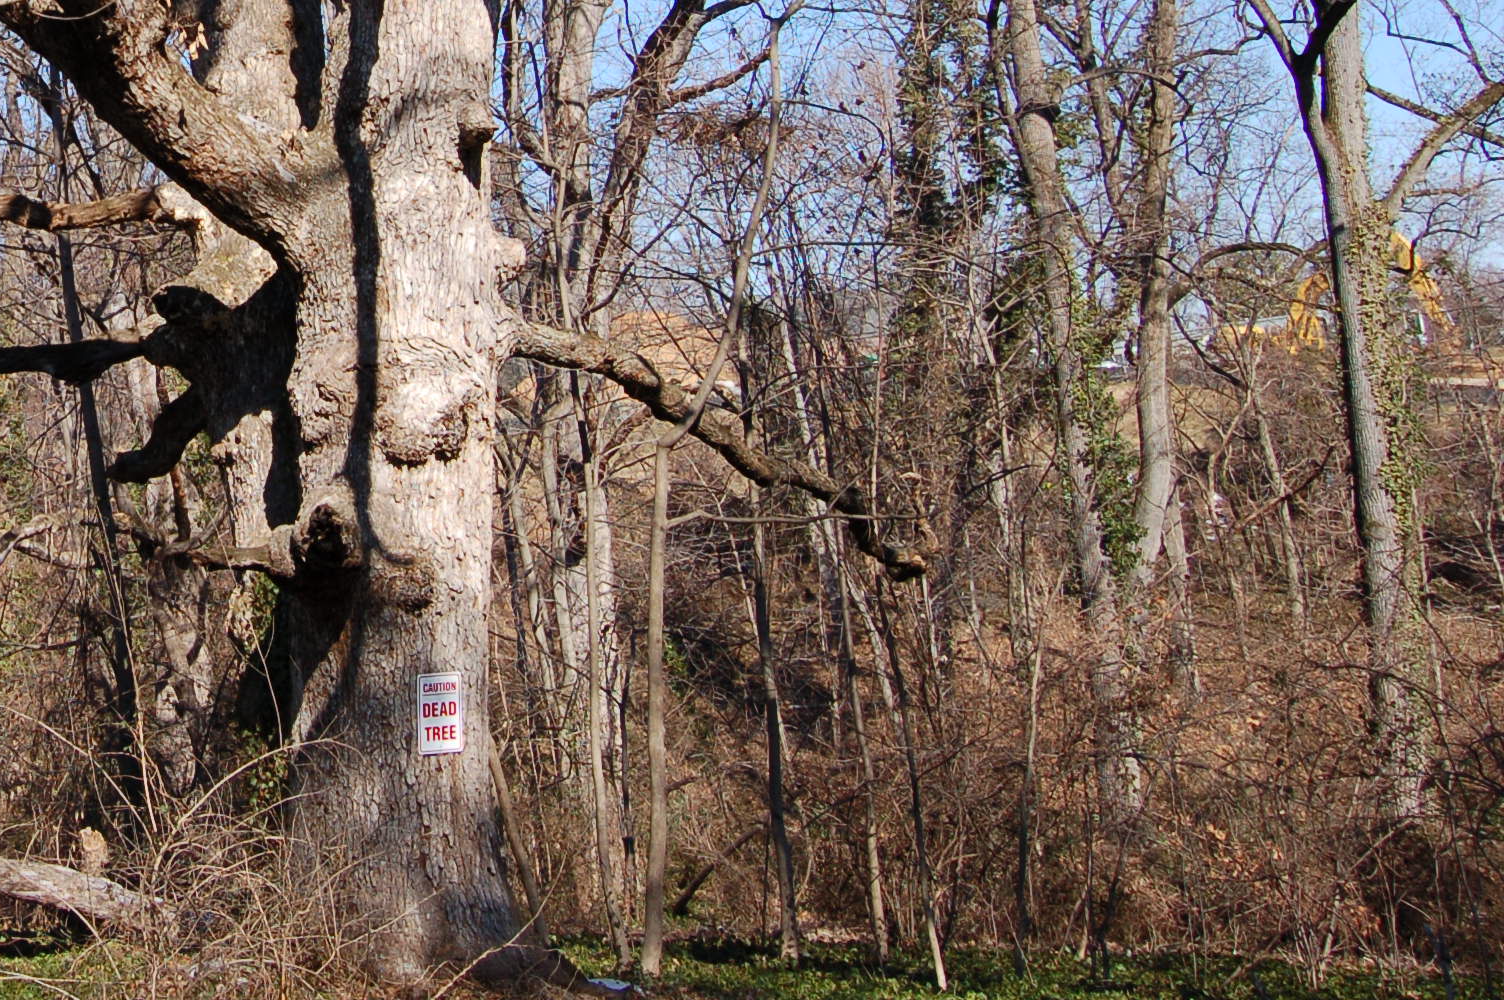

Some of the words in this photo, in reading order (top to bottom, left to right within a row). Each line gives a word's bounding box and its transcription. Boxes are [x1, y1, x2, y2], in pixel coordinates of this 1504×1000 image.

[423, 681, 456, 693] CAUTION
[422, 701, 456, 718] DEAD
[424, 725, 456, 742] TREE
